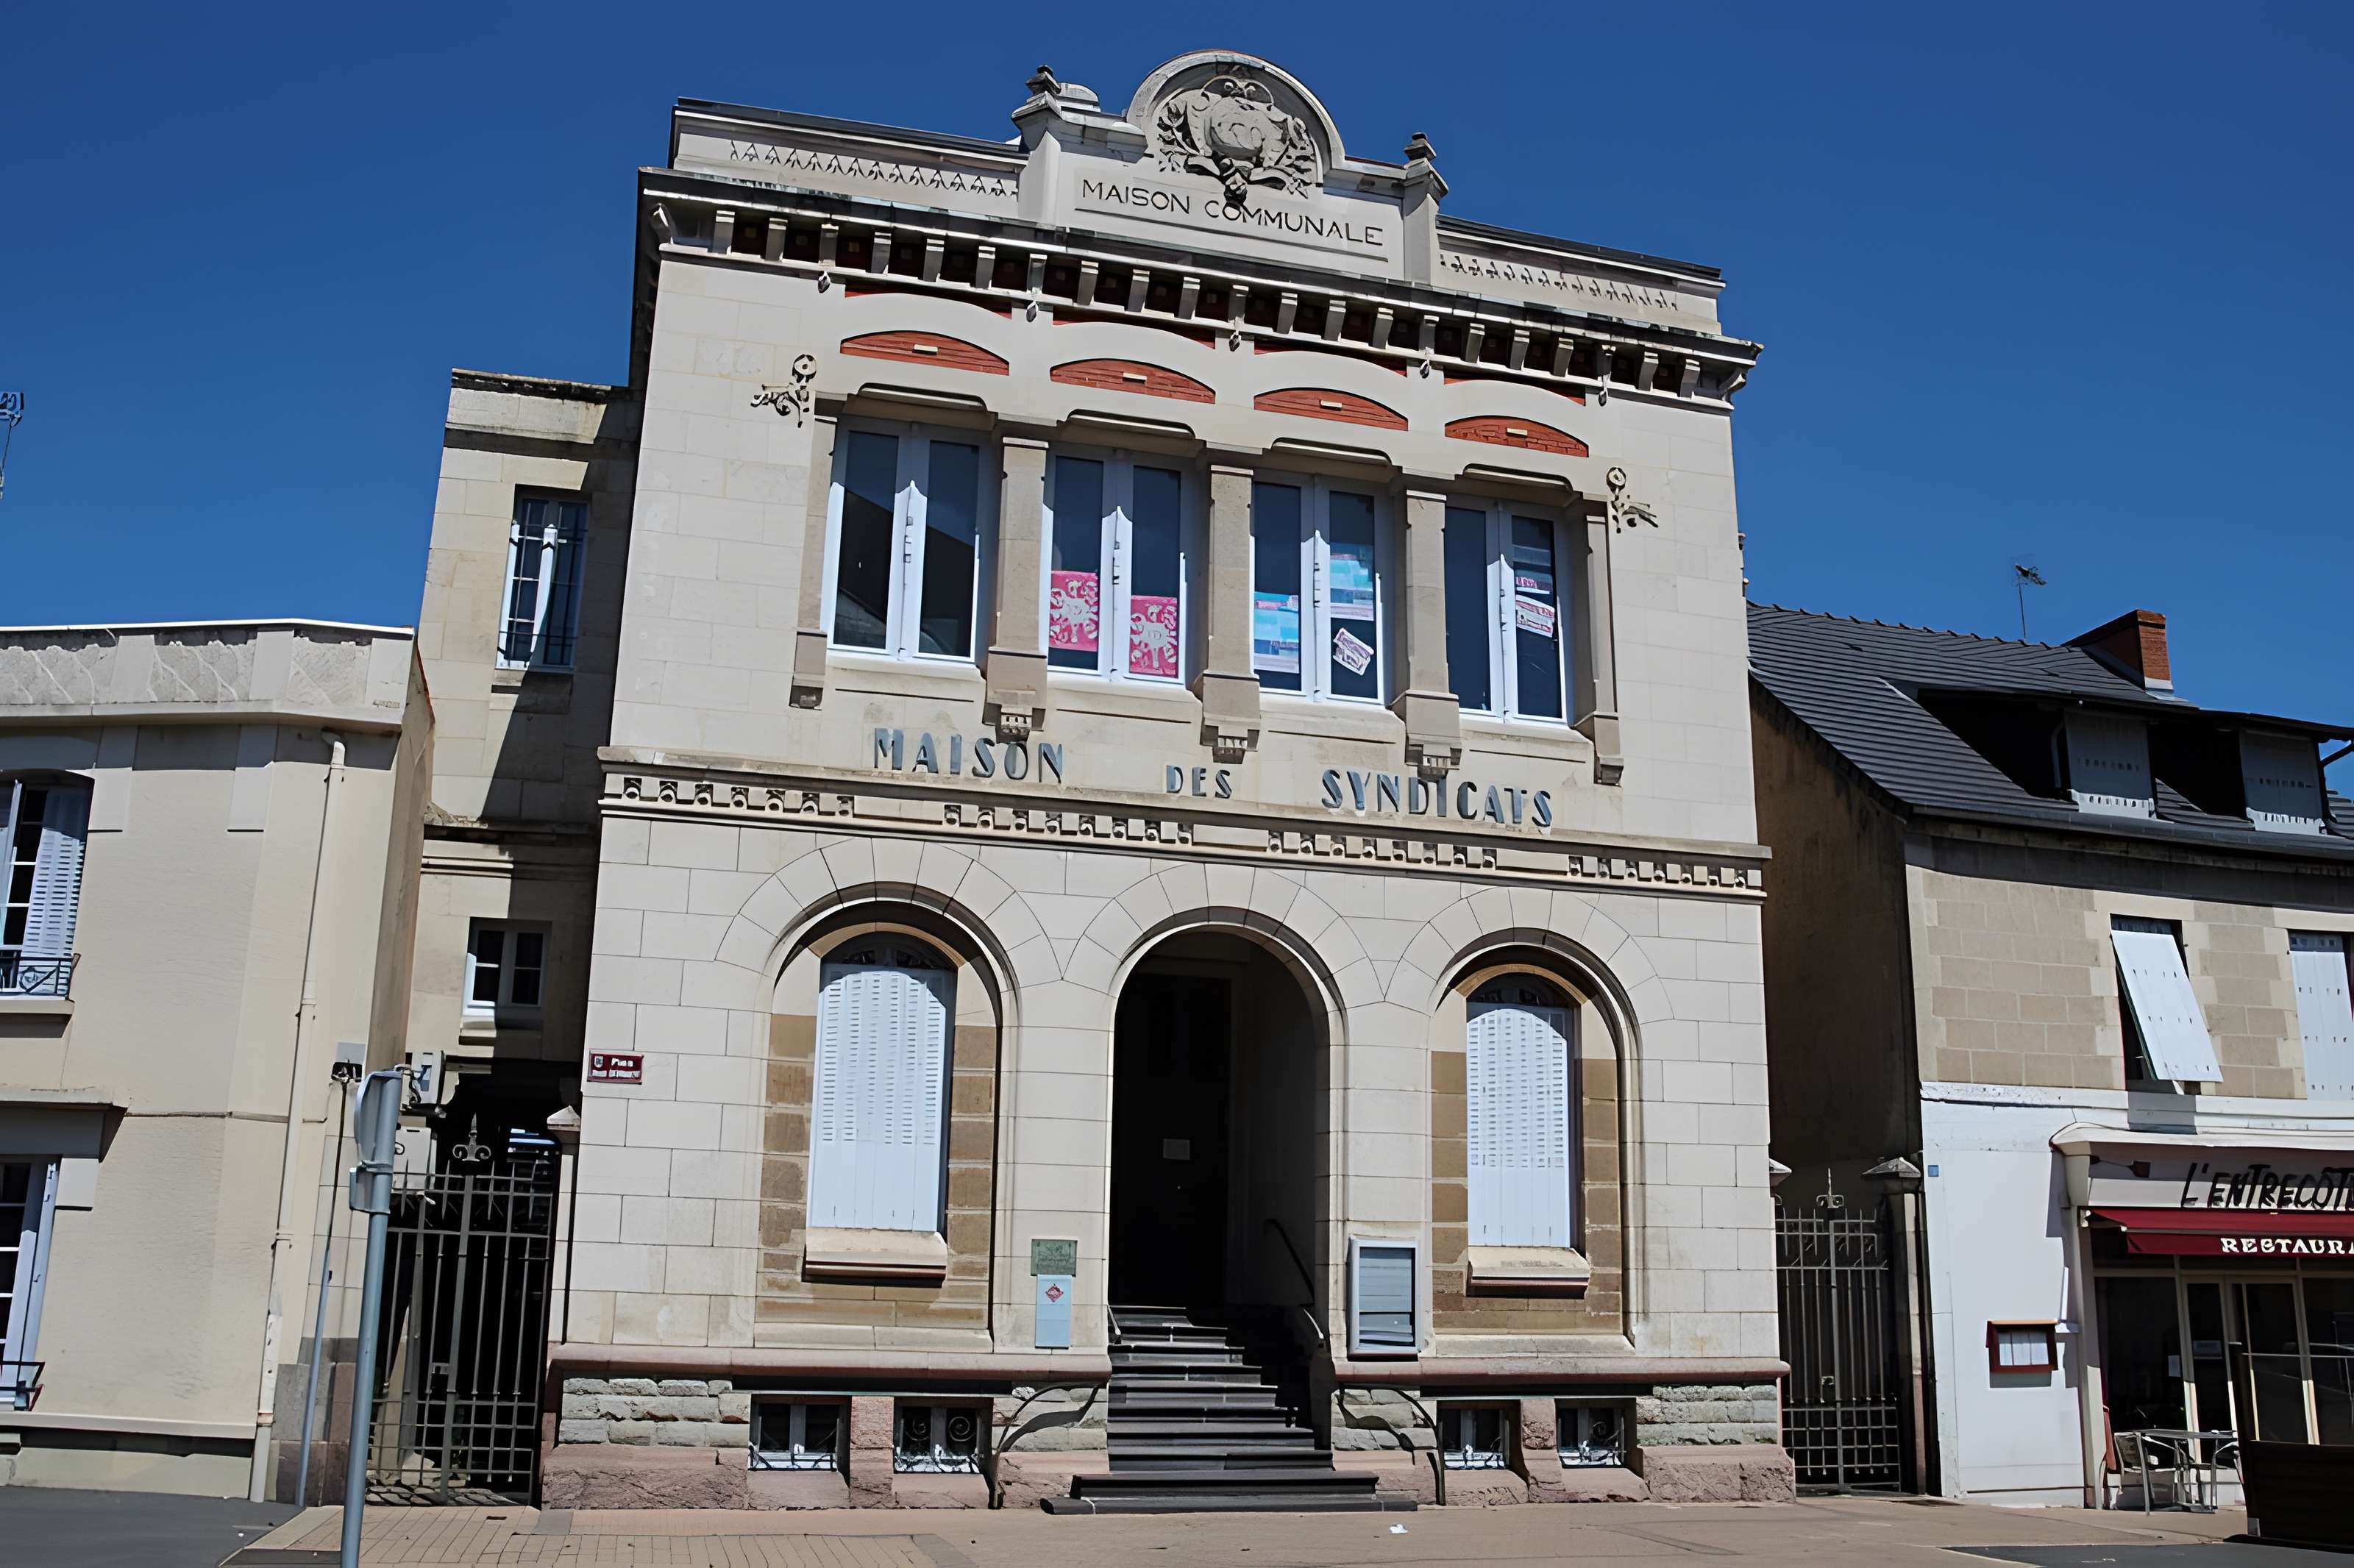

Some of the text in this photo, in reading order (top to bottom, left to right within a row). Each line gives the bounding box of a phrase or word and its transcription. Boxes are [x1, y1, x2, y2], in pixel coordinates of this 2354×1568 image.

[1082, 179, 1384, 246] MAISON COMMUNALE
[874, 728, 1552, 827] MAISON DES SYNDICATS
